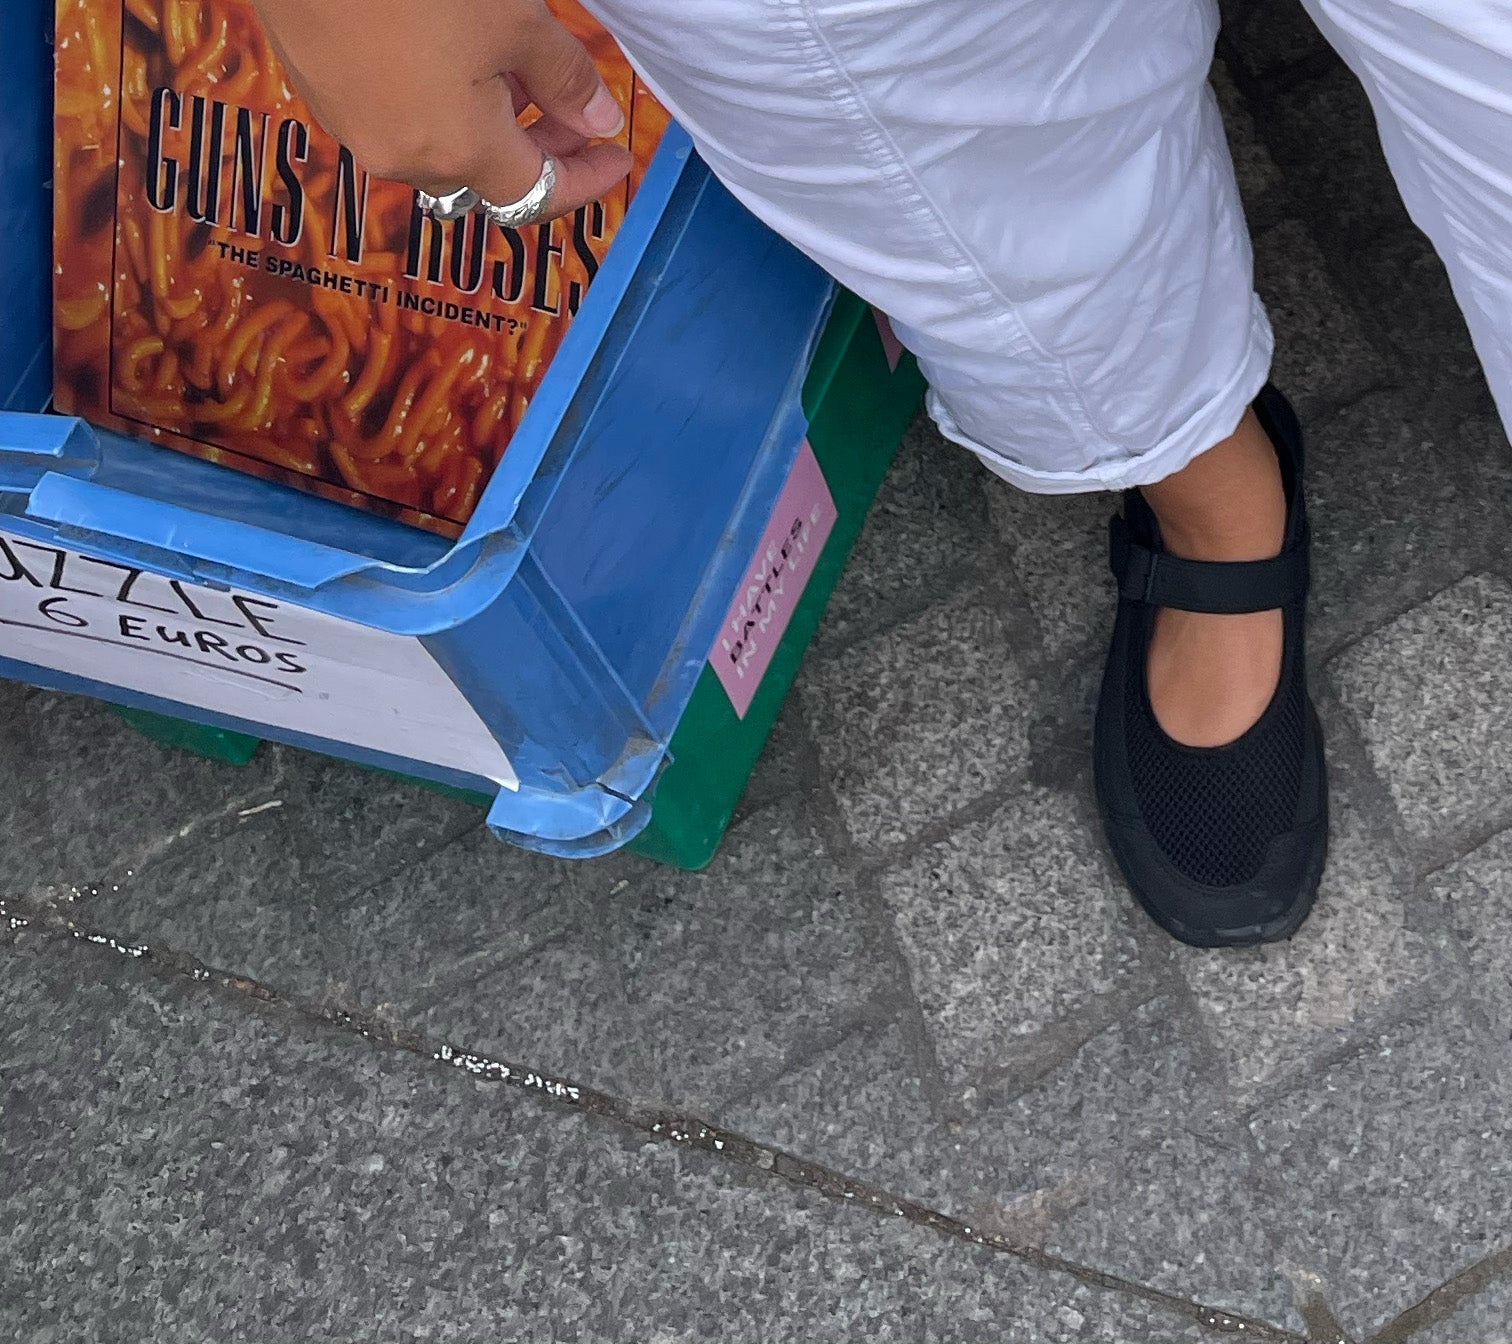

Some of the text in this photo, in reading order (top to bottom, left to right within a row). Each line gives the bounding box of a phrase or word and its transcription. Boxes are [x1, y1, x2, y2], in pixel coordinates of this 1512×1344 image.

[146, 86, 310, 248] GUNS
[265, 255, 390, 304] SPAGHETTI
[38, 597, 88, 627] 6
